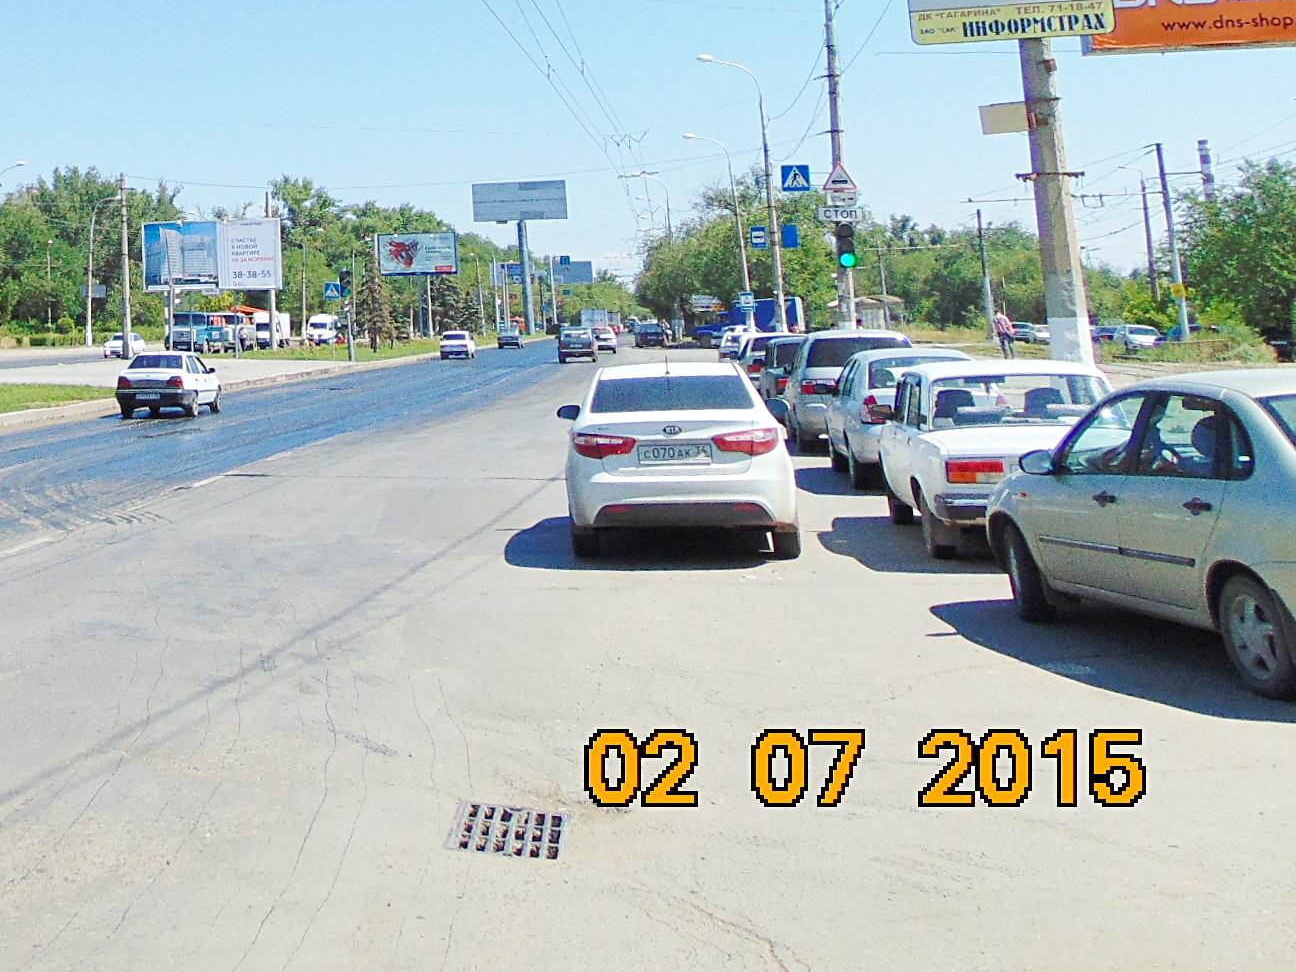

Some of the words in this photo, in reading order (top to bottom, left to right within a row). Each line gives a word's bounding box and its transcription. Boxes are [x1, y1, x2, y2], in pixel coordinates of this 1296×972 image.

[917, 13, 932, 21] ДК
[935, 8, 1001, 19] "ГАГАРИНА"
[962, 13, 1106, 37] ИНФОРМСТРАХ
[823, 209, 857, 218] СТОП
[232, 270, 272, 279] 38-38-55
